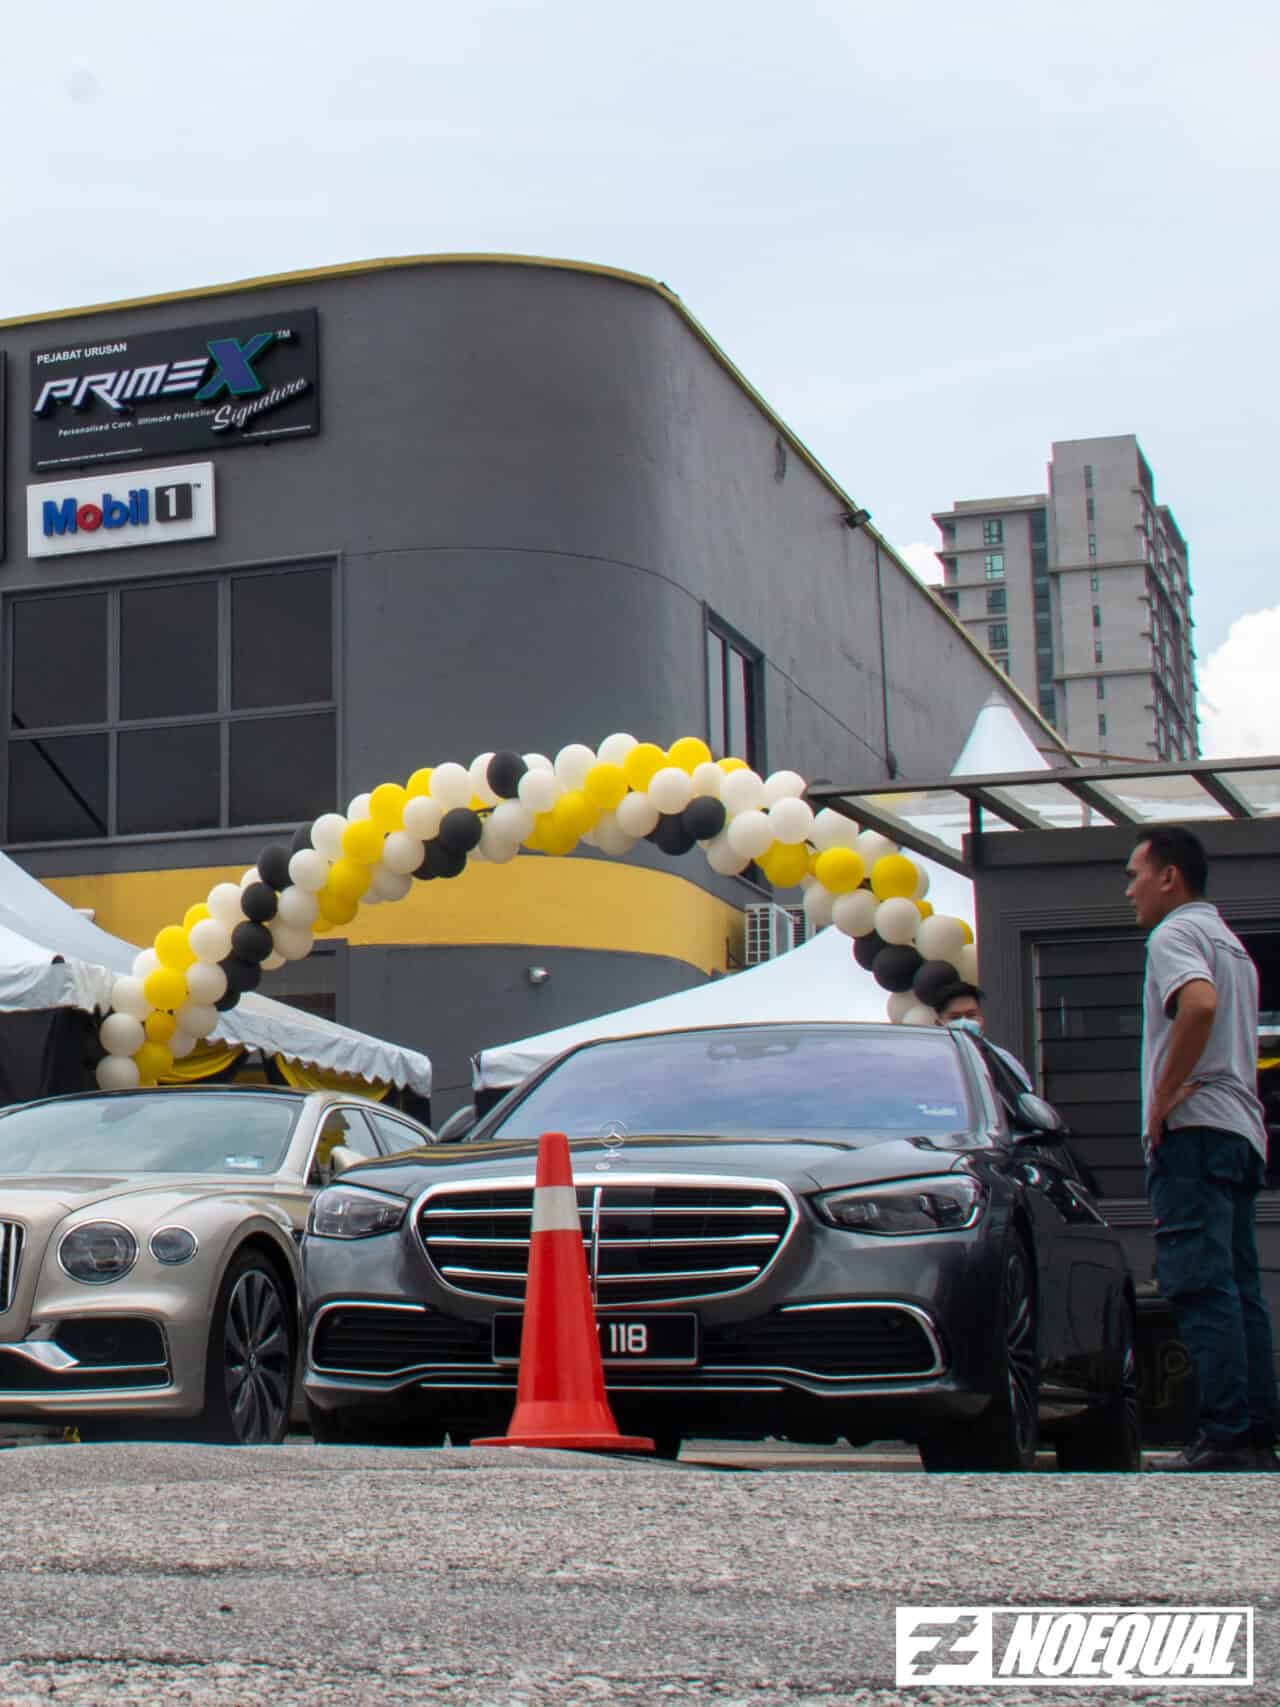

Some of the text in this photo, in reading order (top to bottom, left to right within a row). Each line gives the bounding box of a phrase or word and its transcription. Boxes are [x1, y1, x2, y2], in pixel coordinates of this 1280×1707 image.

[36, 342, 128, 365] PEJABAT URUSAN
[211, 377, 308, 430] Signature
[42, 488, 150, 537] Mobil
[163, 487, 177, 517] 1
[609, 1322, 648, 1353] 118
